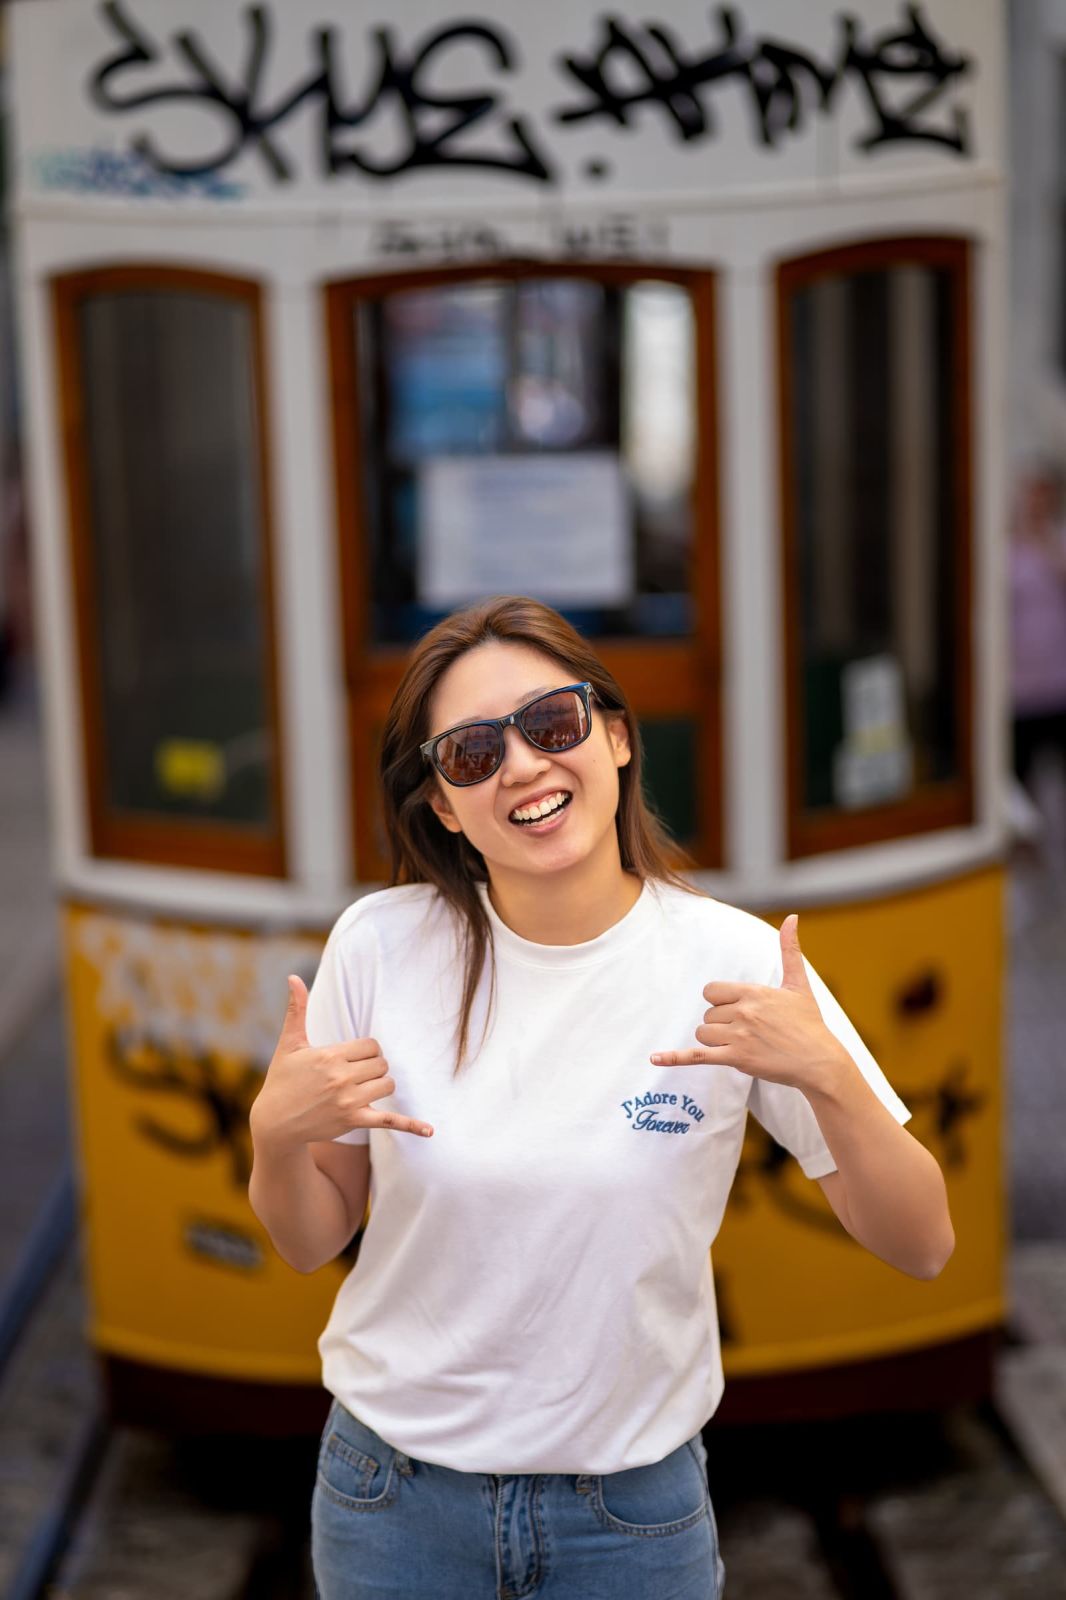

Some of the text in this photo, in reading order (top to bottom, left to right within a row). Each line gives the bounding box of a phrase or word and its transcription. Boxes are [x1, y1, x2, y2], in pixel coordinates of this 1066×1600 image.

[621, 1091, 705, 1122] J'Adore You
[632, 1109, 691, 1134] Forever
